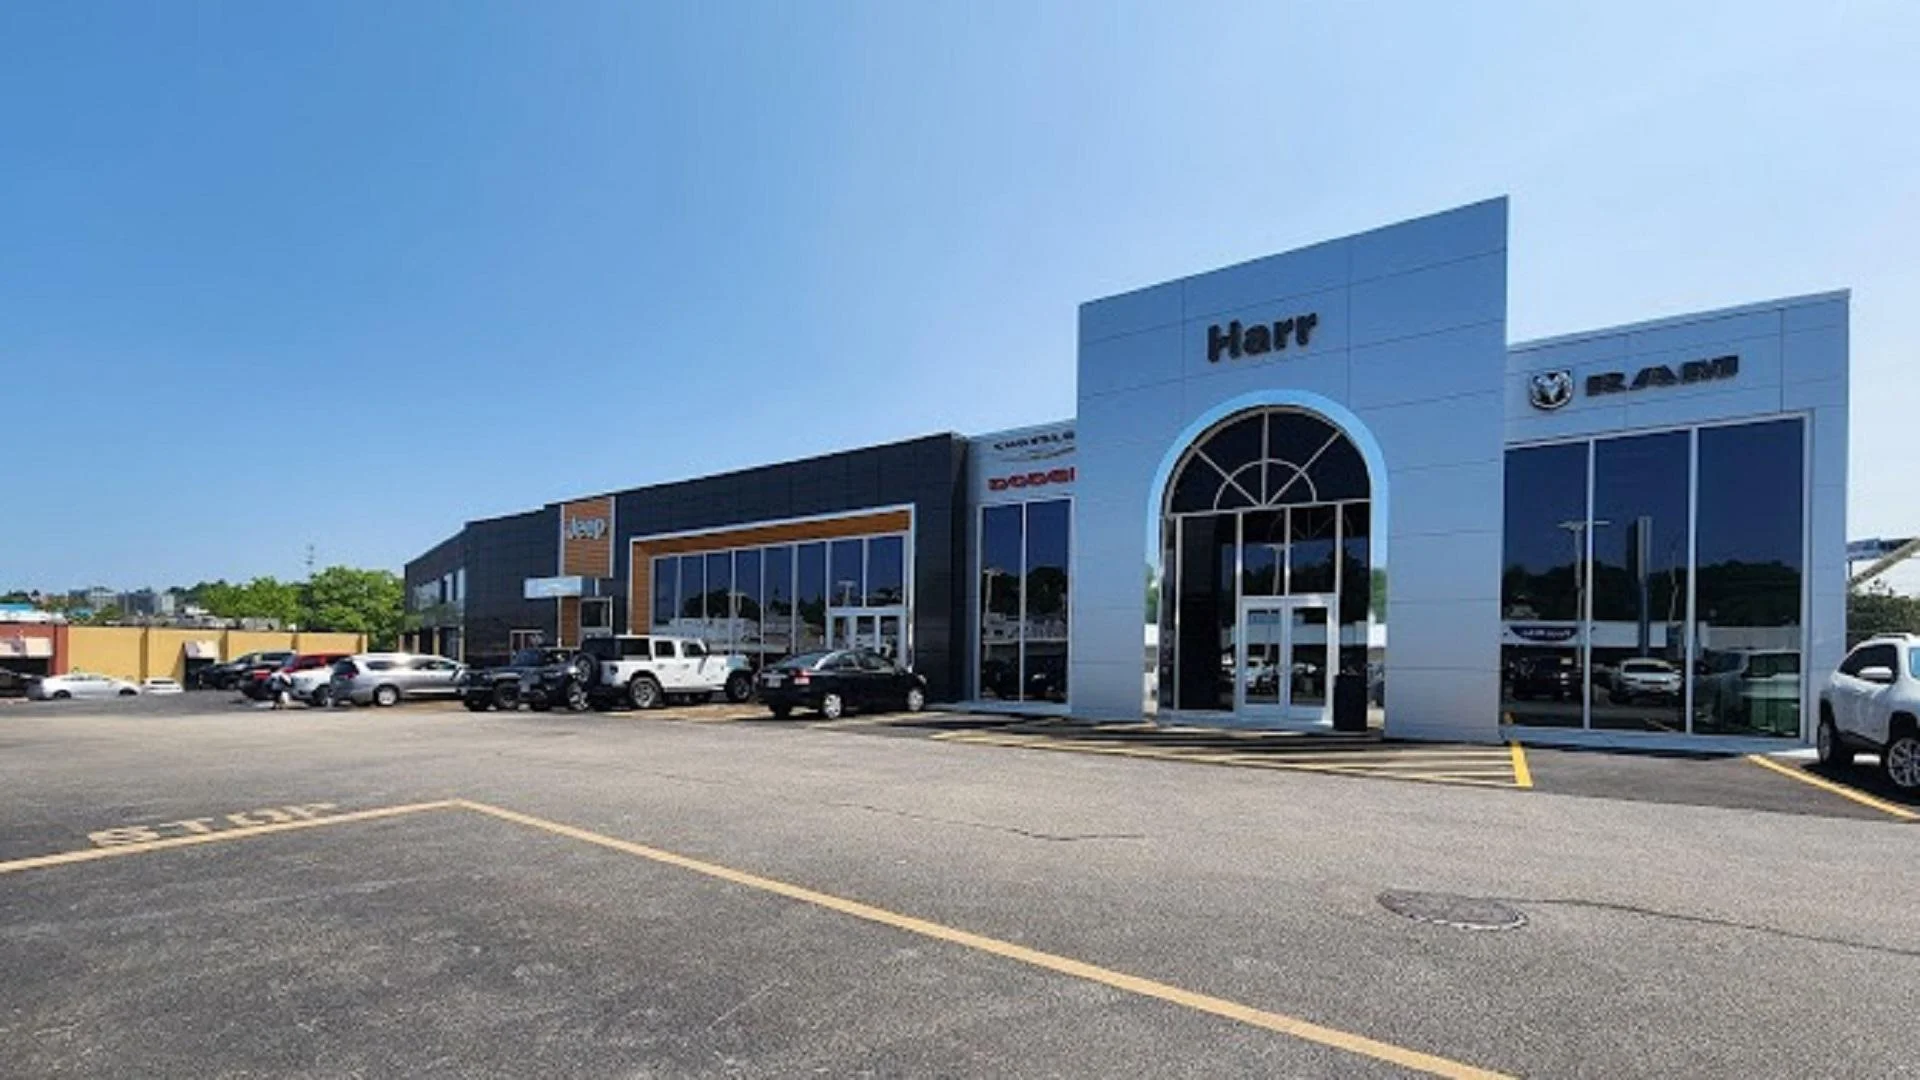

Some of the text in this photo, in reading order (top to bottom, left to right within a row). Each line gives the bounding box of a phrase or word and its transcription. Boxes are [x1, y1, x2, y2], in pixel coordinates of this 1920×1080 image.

[1207, 312, 1317, 363] Harr
[1586, 355, 1739, 397] RAM
[993, 431, 1076, 451] CHRYSLE
[568, 515, 606, 540] Jeep
[87, 803, 338, 847] STOP
